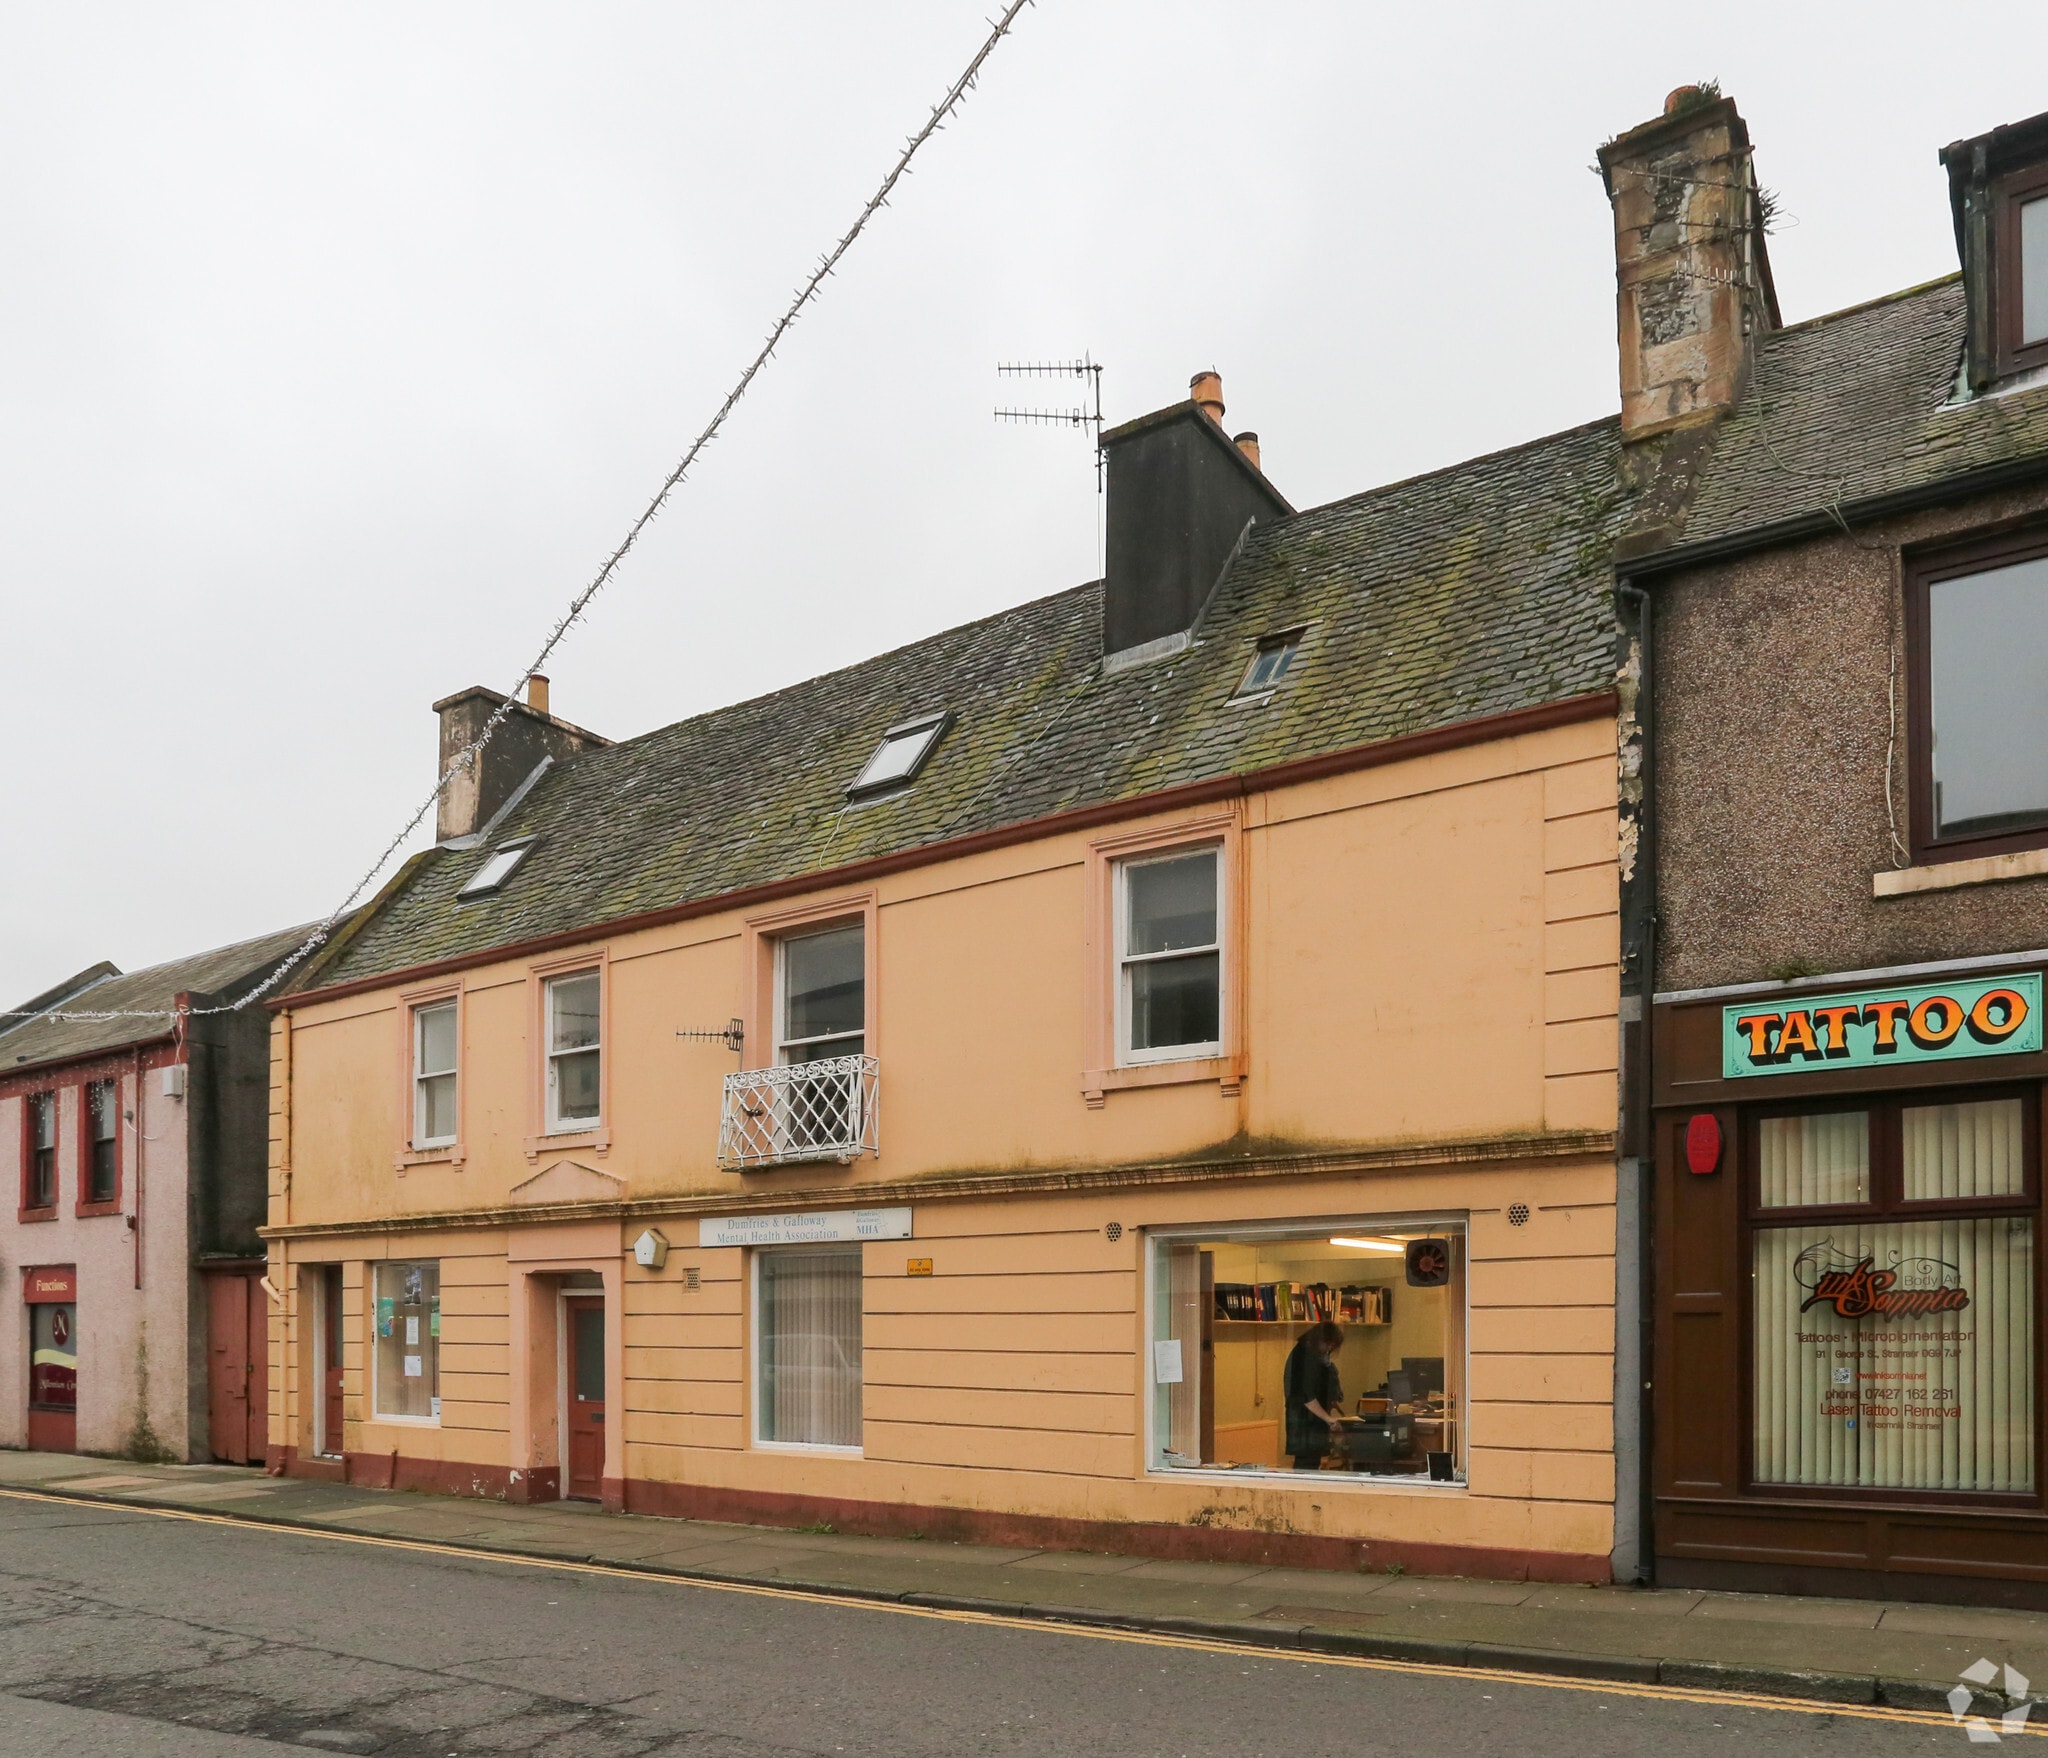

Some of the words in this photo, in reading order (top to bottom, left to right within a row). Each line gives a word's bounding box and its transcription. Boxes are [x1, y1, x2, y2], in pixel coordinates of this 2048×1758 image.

[1736, 988, 2030, 1066] TATTOO
[727, 1218, 769, 1230] Dumfries
[772, 1217, 780, 1228] &
[783, 1214, 827, 1227] Galloway
[717, 1232, 747, 1243] Mental
[751, 1231, 780, 1242] Health
[784, 1229, 839, 1241] Association
[857, 1225, 879, 1234] MHA
[36, 1279, 68, 1292] Functions
[1904, 1275, 1938, 1287] Body
[1943, 1274, 1962, 1285] Art
[1794, 1332, 1841, 1343] Tattoos
[1851, 1331, 1976, 1344] Micropigmentation
[1815, 1350, 1826, 1359] 91
[1835, 1349, 1865, 1360] George
[1881, 1349, 1919, 1358] Stranraer
[1865, 1388, 1901, 1400] 07427
[1905, 1388, 1929, 1400] 162
[1932, 1388, 1953, 1400] 261
[1820, 1402, 1855, 1416] Laser
[1859, 1403, 1899, 1417] Tattoo
[1904, 1403, 1962, 1418] Removal
